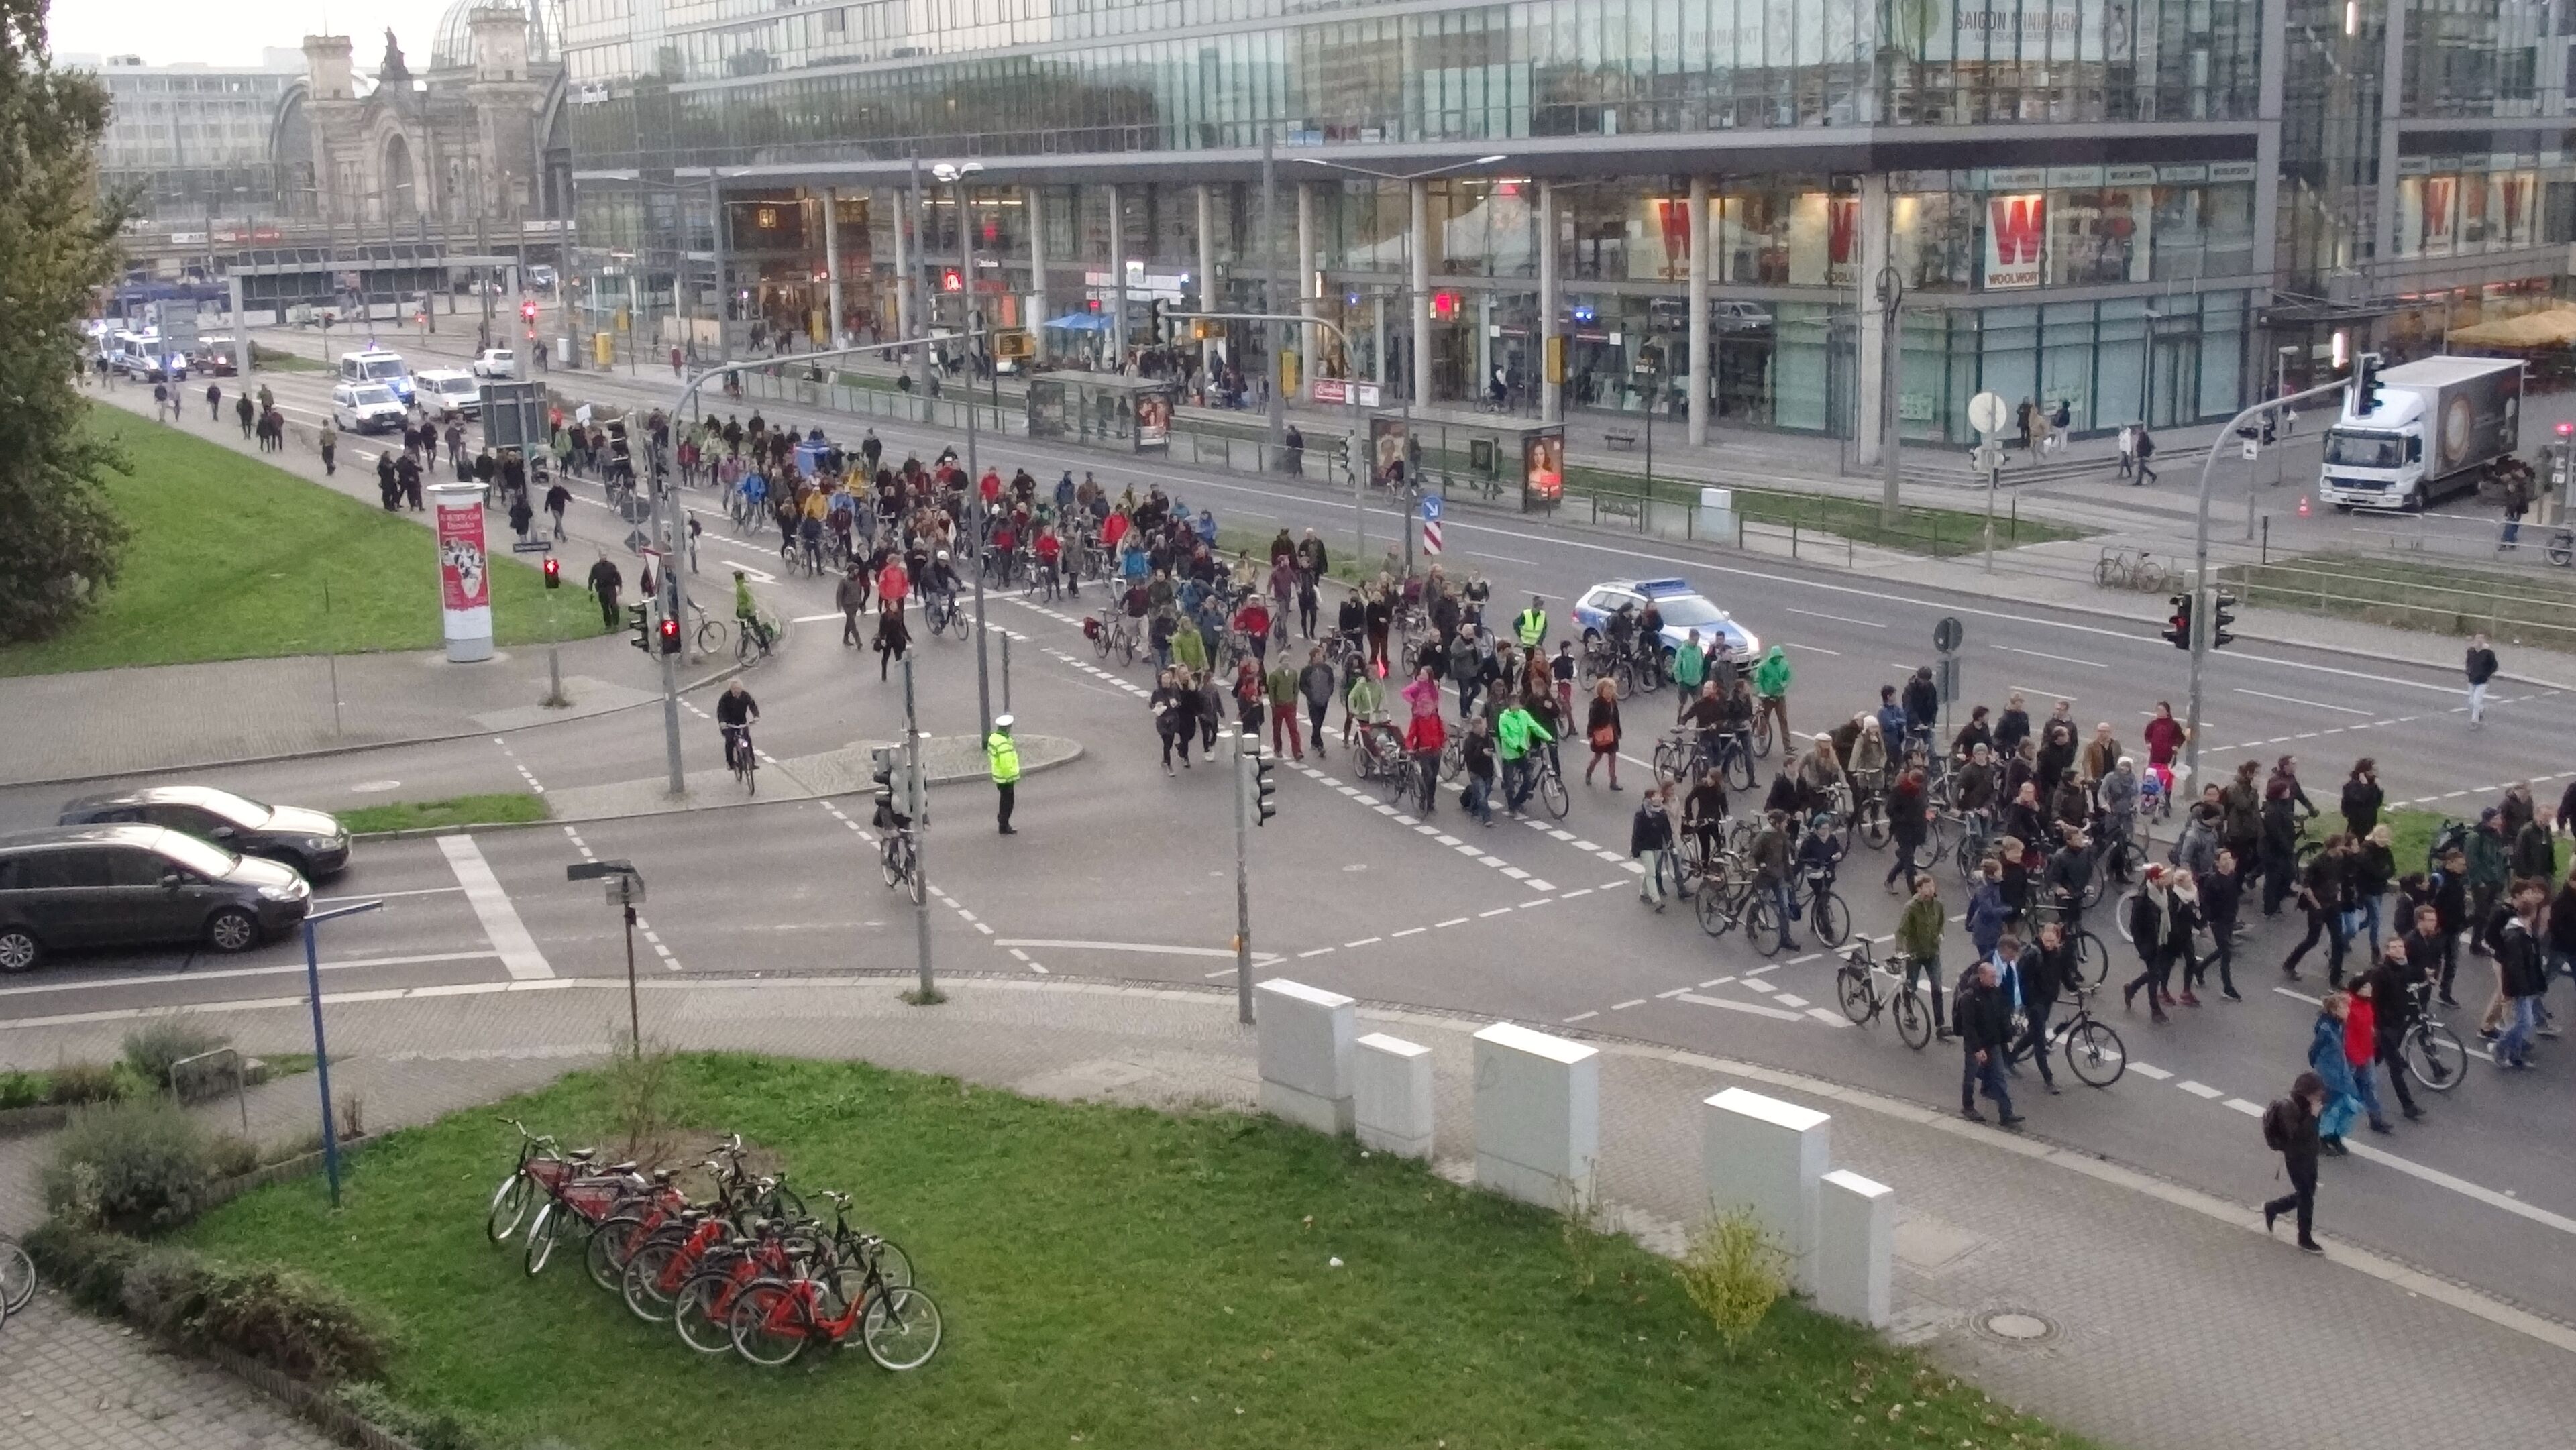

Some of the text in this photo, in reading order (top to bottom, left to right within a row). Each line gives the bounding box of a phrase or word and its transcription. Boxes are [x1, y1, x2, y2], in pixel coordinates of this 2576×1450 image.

[1957, 11, 2086, 31] SAIGON INIMARK
[1990, 200, 2043, 266] W
